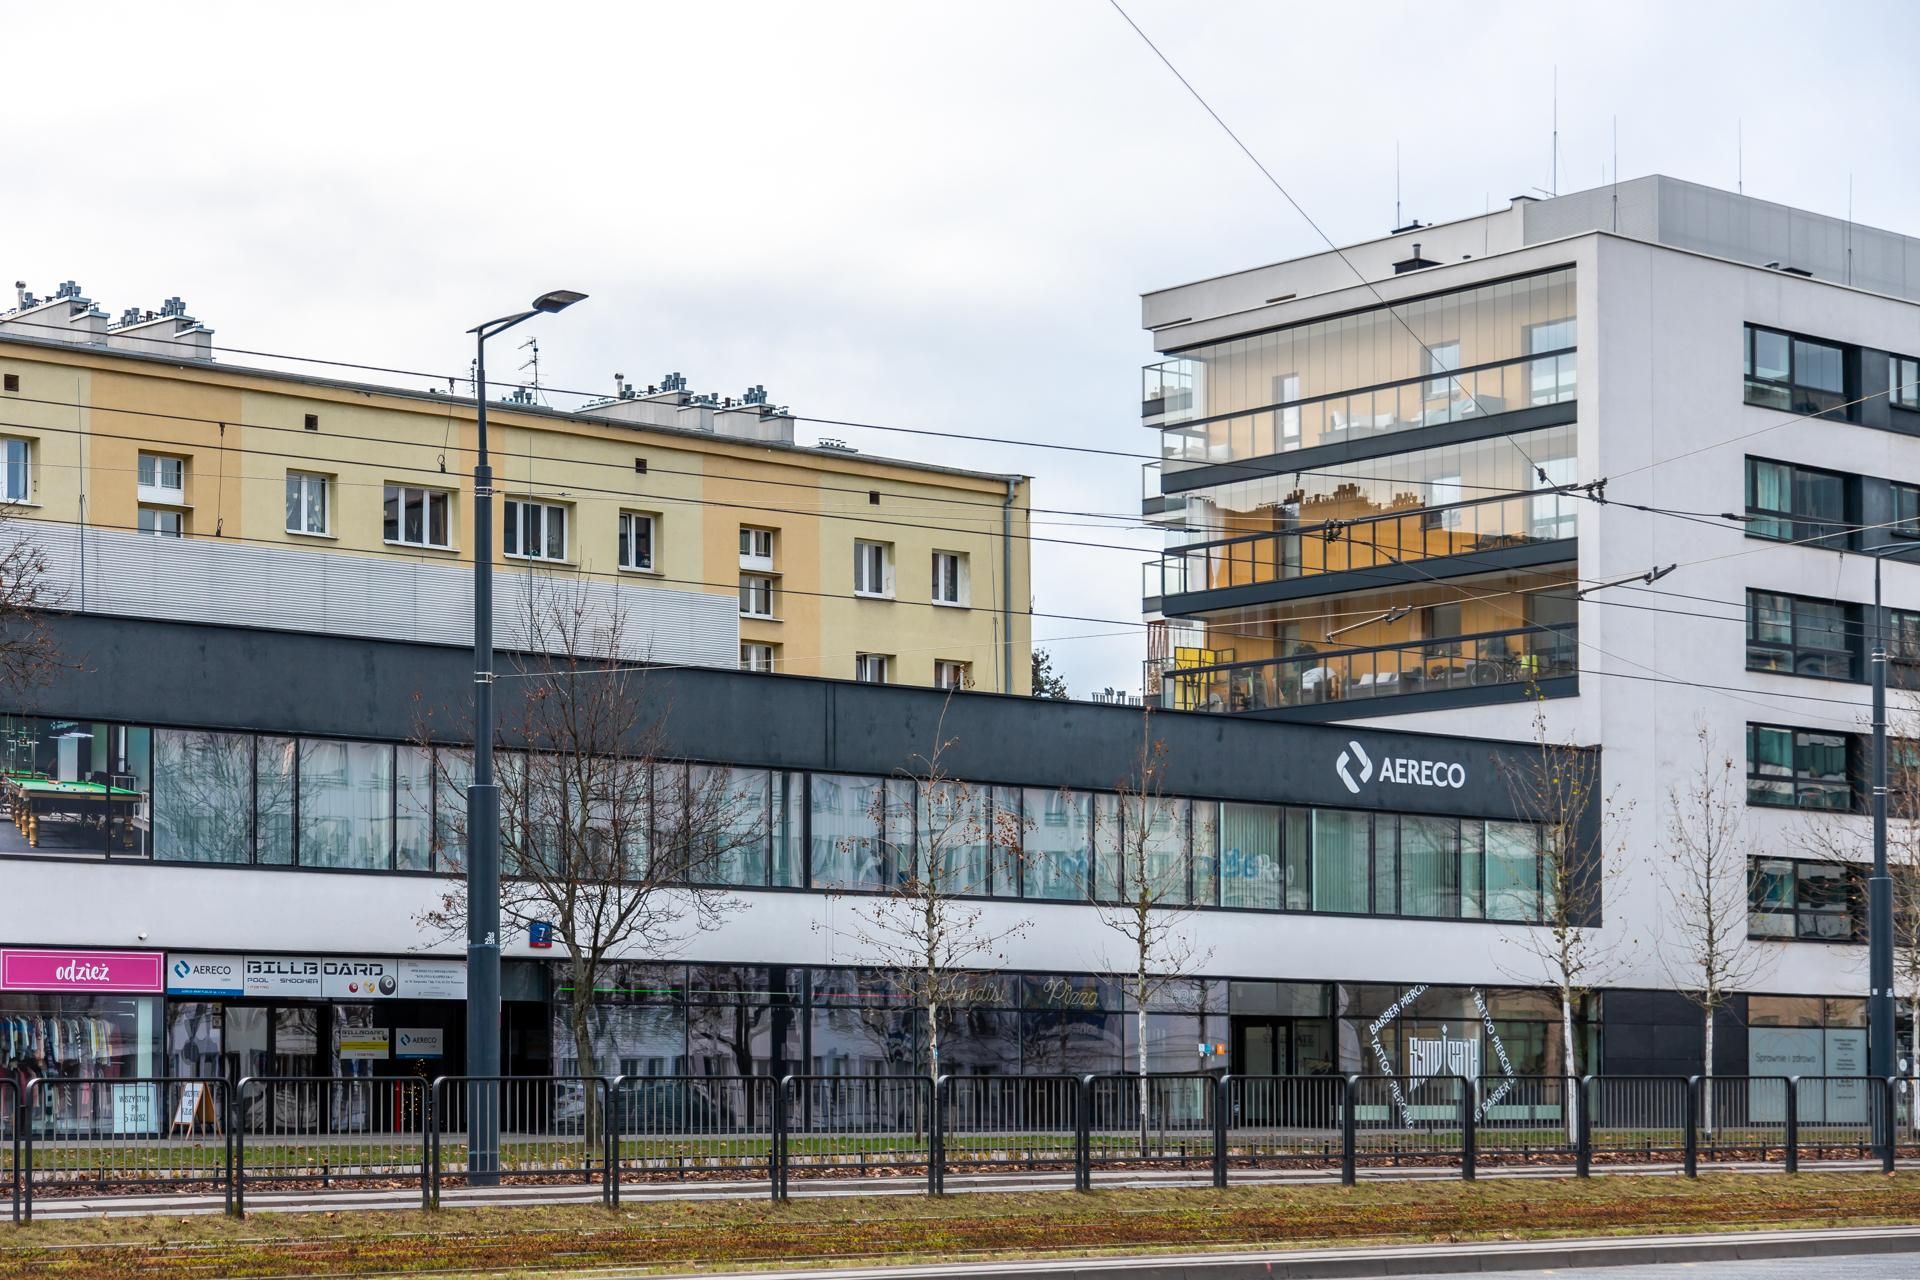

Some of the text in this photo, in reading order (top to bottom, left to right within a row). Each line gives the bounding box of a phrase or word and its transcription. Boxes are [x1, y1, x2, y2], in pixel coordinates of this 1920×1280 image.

[1379, 757, 1466, 789] AERECO
[538, 927, 546, 938] 7
[55, 959, 110, 983] odzież
[193, 965, 231, 976] AERECO
[247, 960, 384, 976] BILLBOARD
[279, 977, 319, 985] SNOOKER
[1043, 978, 1100, 1006] Pizza
[1369, 1003, 1400, 1036] BARBER
[1474, 991, 1496, 1035] TATTOO
